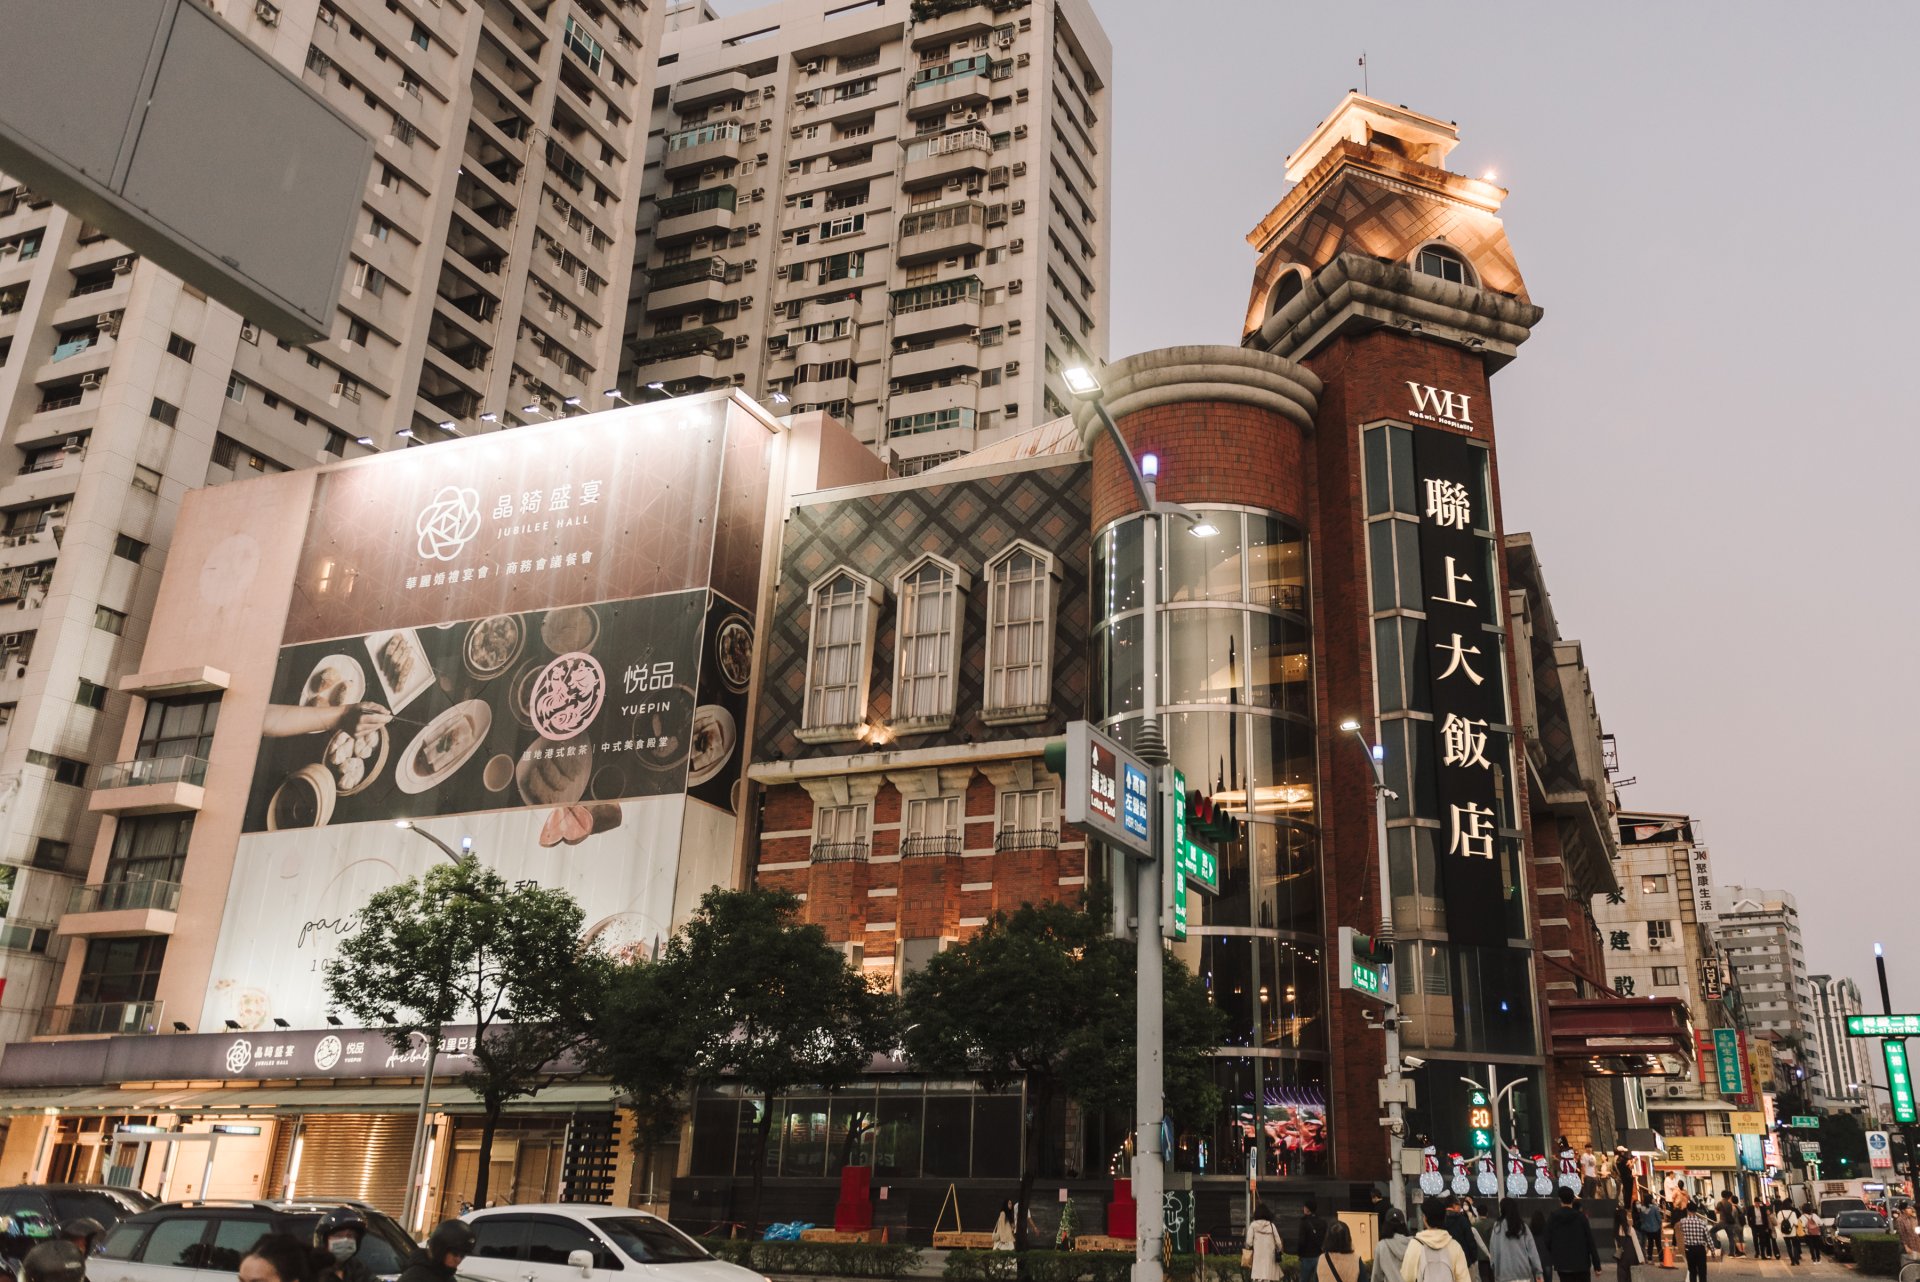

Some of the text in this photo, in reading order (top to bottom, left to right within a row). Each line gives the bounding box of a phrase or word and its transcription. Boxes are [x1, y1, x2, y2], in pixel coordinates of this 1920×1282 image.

[1405, 381, 1473, 423] WH
[1438, 417, 1474, 432] Hospitality
[493, 480, 602, 520] 晶綺盛宴
[497, 514, 590, 539] JUBILEE HALL
[1423, 478, 1495, 860] 聯上大飯店
[620, 701, 671, 716] YUEPIN
[1695, 863, 1712, 911] 聚康生活
[1888, 1026, 1904, 1034] 2nd
[1471, 1108, 1489, 1128] 20
[1668, 1145, 1685, 1161] 產
[1690, 1153, 1726, 1161] 5571199
